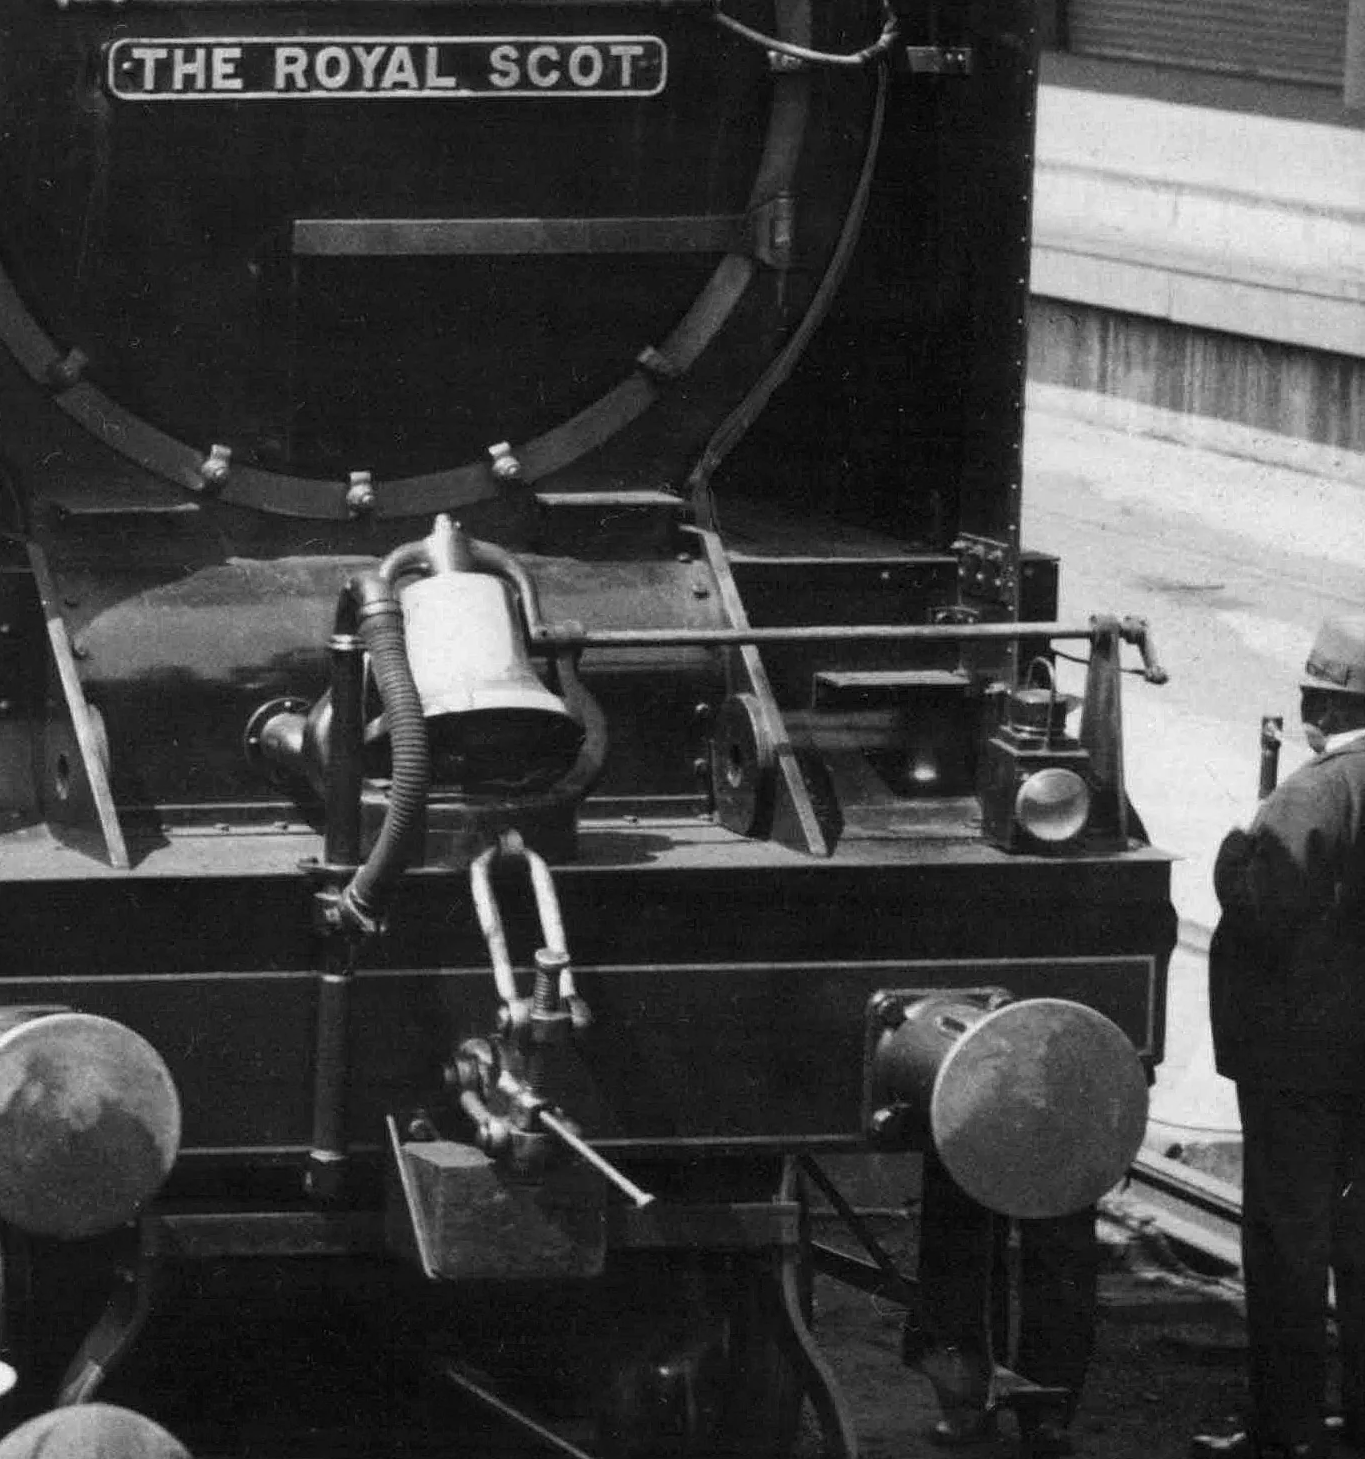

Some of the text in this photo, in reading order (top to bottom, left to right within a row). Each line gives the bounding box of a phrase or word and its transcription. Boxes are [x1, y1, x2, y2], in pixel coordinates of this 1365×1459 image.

[132, 44, 646, 91] THE ROYAL SCOT
